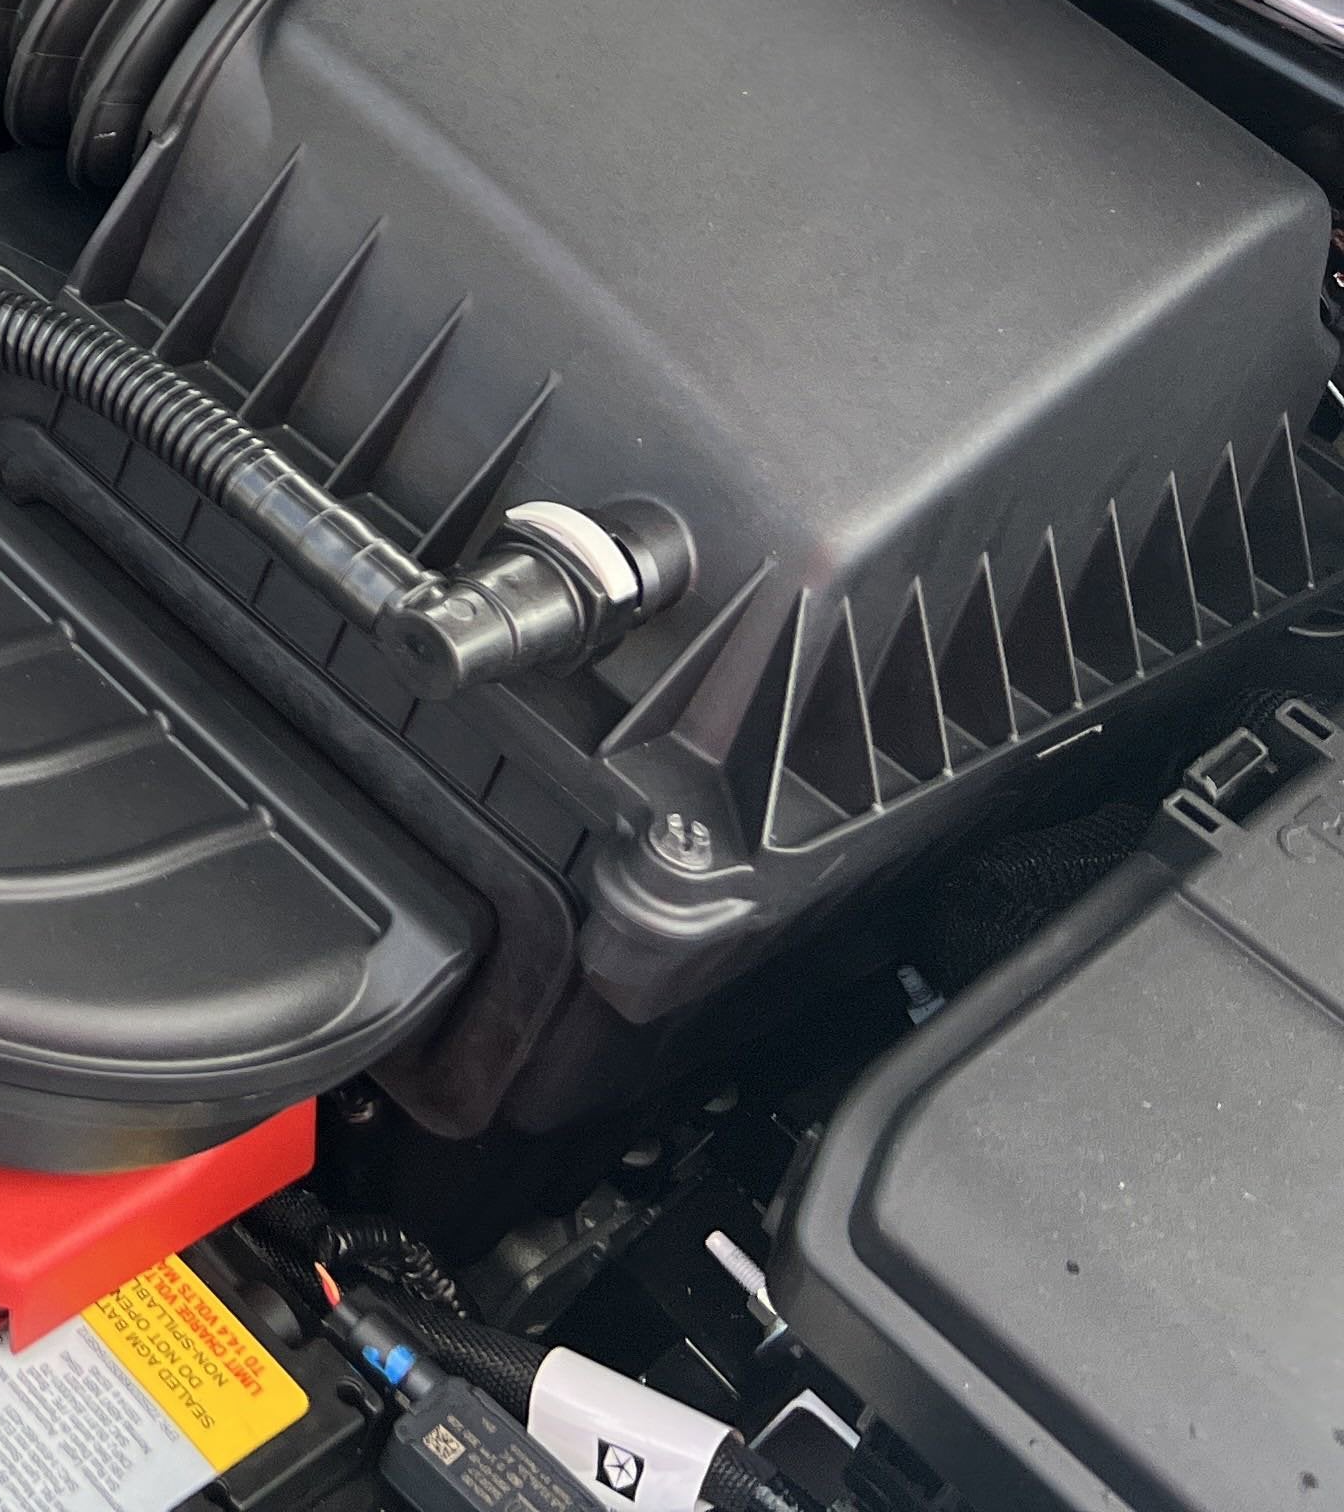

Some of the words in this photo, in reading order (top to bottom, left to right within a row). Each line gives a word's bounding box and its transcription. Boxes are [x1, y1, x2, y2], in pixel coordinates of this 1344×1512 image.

[107, 1285, 153, 1334] OPEN
[175, 1281, 221, 1328] VOLTS
[123, 1330, 162, 1371] AGM
[146, 1329, 182, 1367] NOT
[173, 1302, 230, 1359] CHARGE
[213, 1323, 247, 1357] 14.4
[176, 1362, 204, 1390] DO
[223, 1356, 264, 1398] LIMIT
[240, 1352, 267, 1378] TO
[155, 1365, 217, 1430] SEALED
